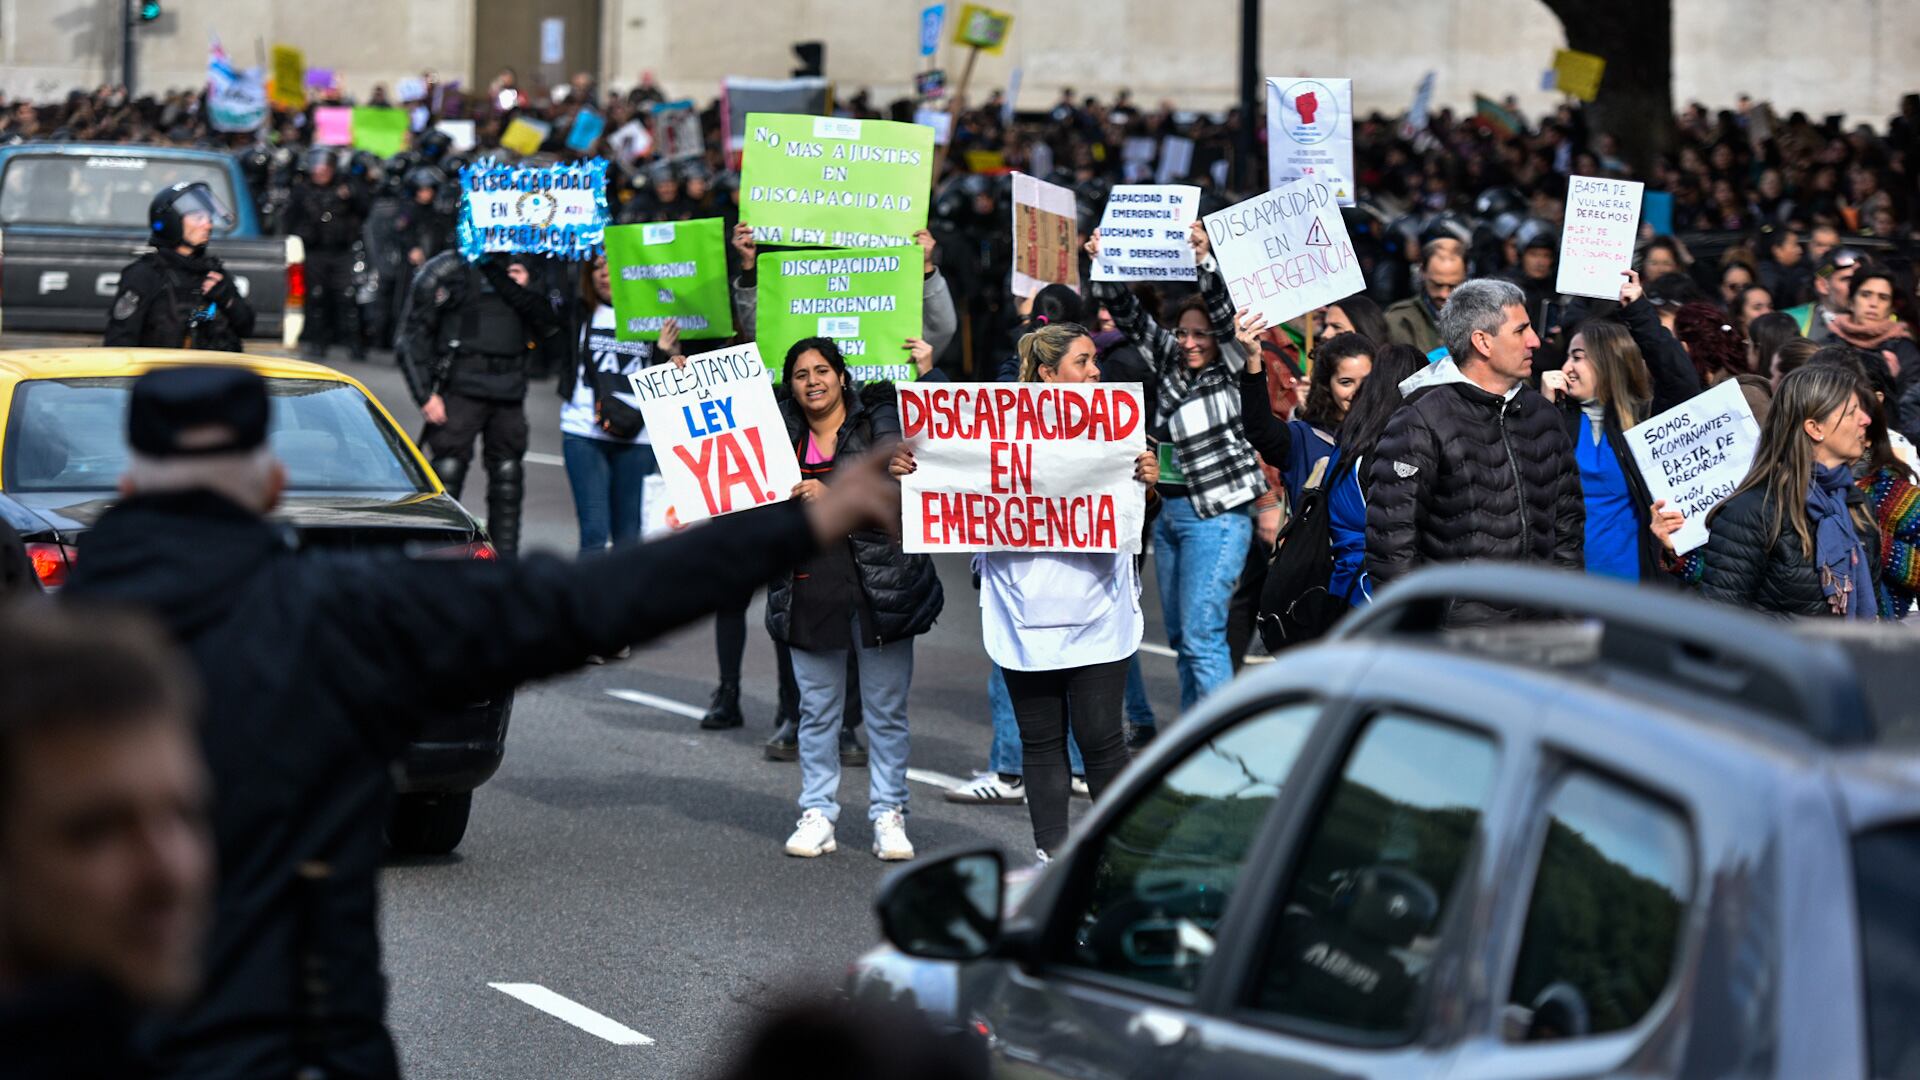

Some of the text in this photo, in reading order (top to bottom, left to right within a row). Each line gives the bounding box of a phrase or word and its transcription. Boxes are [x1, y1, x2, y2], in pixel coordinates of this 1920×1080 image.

[756, 127, 780, 148] NO
[786, 141, 823, 158] MAS
[823, 166, 847, 181] EN
[751, 186, 912, 211] DISCAPACIDAD
[1169, 195, 1183, 204] EN
[1613, 184, 1627, 195] DE
[491, 202, 508, 218] EN
[1578, 198, 1632, 211] VULNERAR
[1576, 208, 1633, 223] DERECHOS!
[482, 226, 577, 247] MERGENCIA
[791, 227, 824, 244] LEY
[1166, 231, 1185, 240] POR
[1104, 248, 1180, 259] LOS DERECHOS
[1263, 233, 1291, 259] EN
[782, 256, 899, 276] DISCAPACIDAD
[1118, 266, 1168, 276] NUESTROS
[1170, 267, 1196, 277] HIJOS
[828, 277, 848, 292] EN
[790, 296, 895, 315] EMERGENCIA
[635, 351, 761, 402] NECESITAMOS
[697, 389, 711, 400] LA
[682, 396, 736, 438] LEY
[900, 388, 1140, 442] DISCAPACIDAD
[1644, 413, 1691, 445] SOMOS
[1651, 413, 1731, 460] ACOMPAÑANTES
[1662, 432, 1735, 476] BASTA DE
[672, 426, 776, 516] YA!
[990, 442, 1032, 494] EN
[921, 492, 1117, 549] EMERGENCIA
